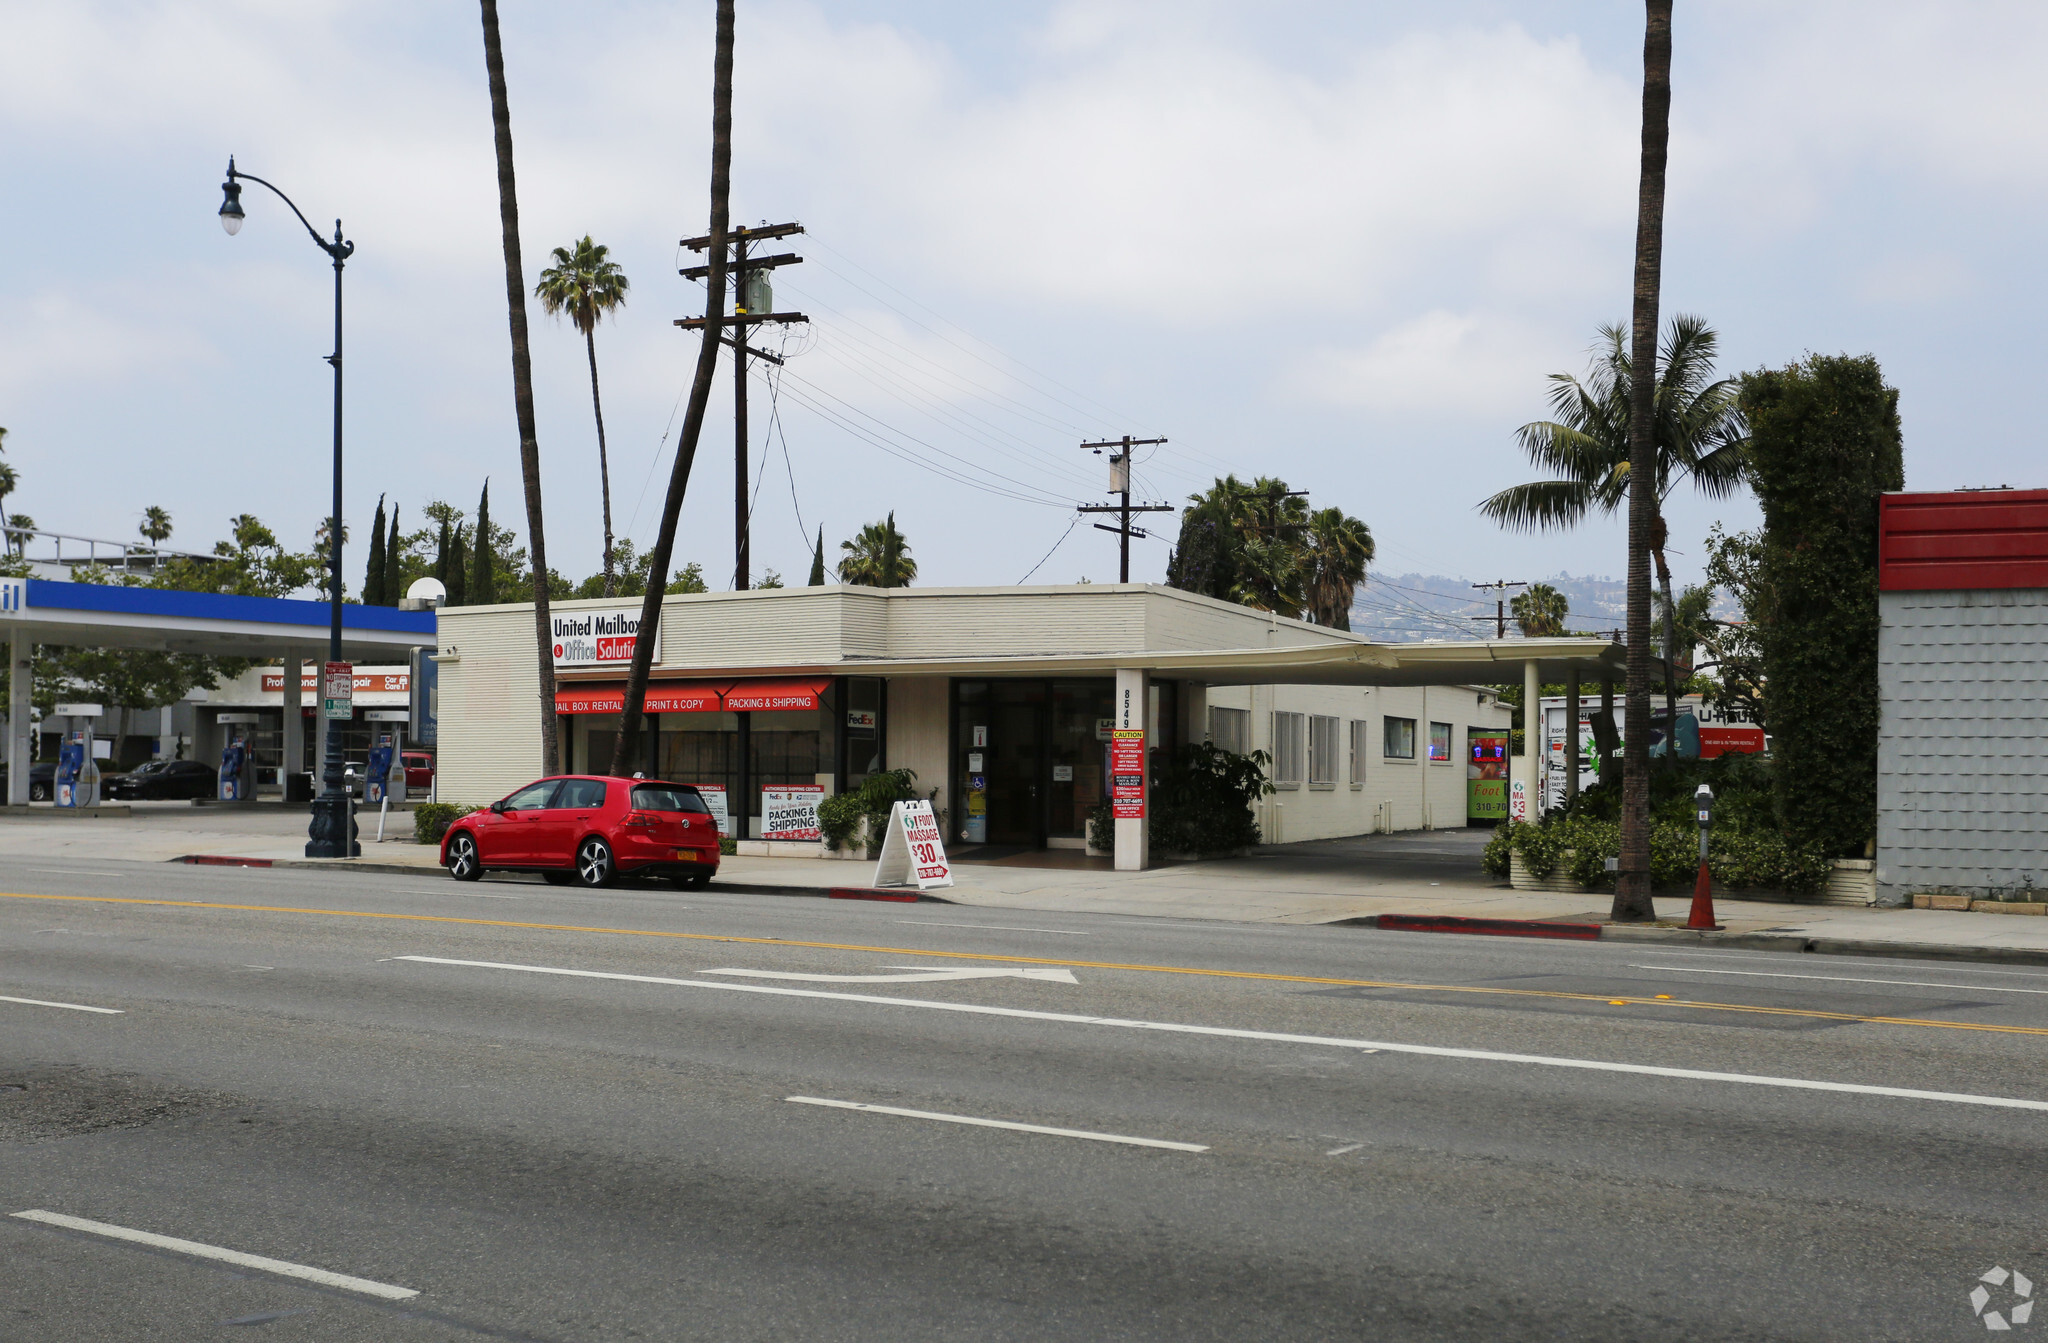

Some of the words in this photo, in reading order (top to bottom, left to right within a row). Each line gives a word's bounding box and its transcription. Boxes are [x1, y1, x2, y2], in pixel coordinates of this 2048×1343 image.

[554, 615, 591, 637] United
[564, 640, 596, 660] Office
[572, 702, 588, 711] BOX
[592, 701, 622, 710] RENTAL
[646, 700, 671, 710] PRINT
[673, 700, 678, 709] &
[680, 700, 704, 709] COPY
[728, 698, 764, 708] PACKING
[765, 698, 770, 708] &
[772, 697, 811, 707] SHIPPING
[848, 713, 873, 724] FedEx
[1474, 783, 1500, 796] Foot
[769, 808, 807, 820] PACKING
[809, 807, 815, 816] &
[769, 817, 815, 831] SHIPPING
[918, 815, 934, 826] FOOT
[907, 829, 939, 842] MASSAGE
